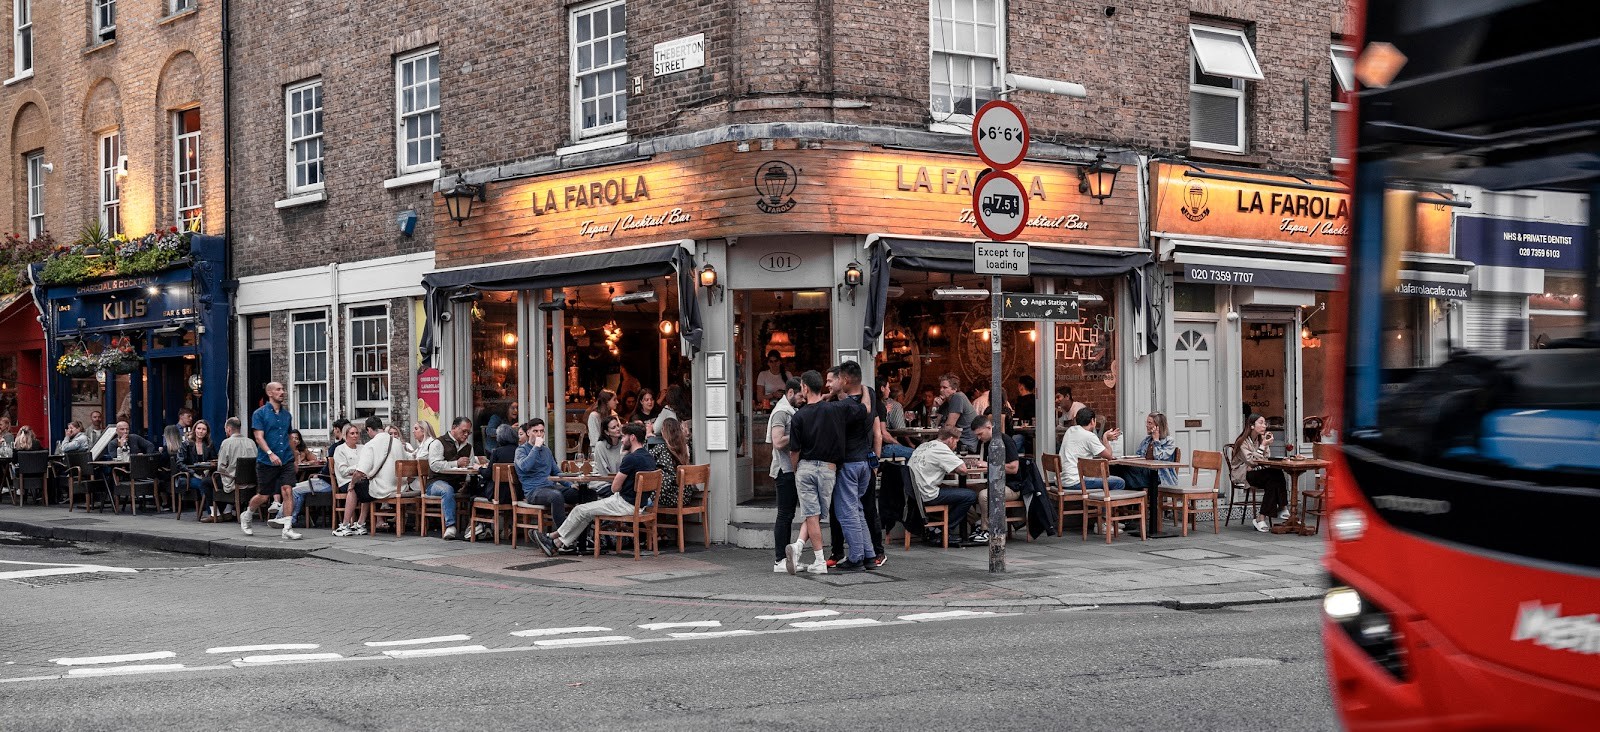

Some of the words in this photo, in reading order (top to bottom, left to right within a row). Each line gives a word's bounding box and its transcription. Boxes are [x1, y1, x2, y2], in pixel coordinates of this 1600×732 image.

[655, 40, 704, 62] THEBERTON
[655, 58, 686, 74] STREET
[897, 165, 933, 193] LA
[941, 168, 1047, 200] FAA
[532, 188, 559, 215] LA
[564, 175, 651, 209] FAROLA
[994, 195, 1011, 210] 7.5
[767, 201, 795, 213] FAROLA
[1238, 189, 1264, 213] LA
[1270, 193, 1349, 220] FAROLA
[579, 219, 609, 238] Tapas
[621, 211, 669, 231] Cocktail
[668, 207, 692, 224] Bar
[1025, 214, 1065, 229] cktail
[1064, 213, 1089, 230] Bar
[1279, 218, 1309, 235] Tapas
[1320, 221, 1349, 236] Cockt
[1503, 232, 1517, 241] NHS
[1517, 233, 1522, 242] &
[1522, 234, 1548, 244] PRIVATE
[1547, 235, 1573, 245] DENTIST
[978, 247, 1009, 259] Except
[1013, 248, 1025, 258] for
[1519, 248, 1530, 257] 020
[1531, 249, 1545, 258] 7359
[1545, 249, 1560, 258] 6103
[769, 255, 793, 269] 101
[986, 260, 1018, 271] loading
[1191, 268, 1208, 280] 020
[1209, 270, 1232, 282] 7359
[1233, 271, 1254, 283] 7707
[76, 282, 112, 294] CHARCOAL
[112, 280, 118, 289] &
[102, 298, 147, 320] KILIS
[1093, 313, 1115, 332] £10
[1055, 326, 1099, 343] LUNCH
[1055, 342, 1096, 360] PLATE
